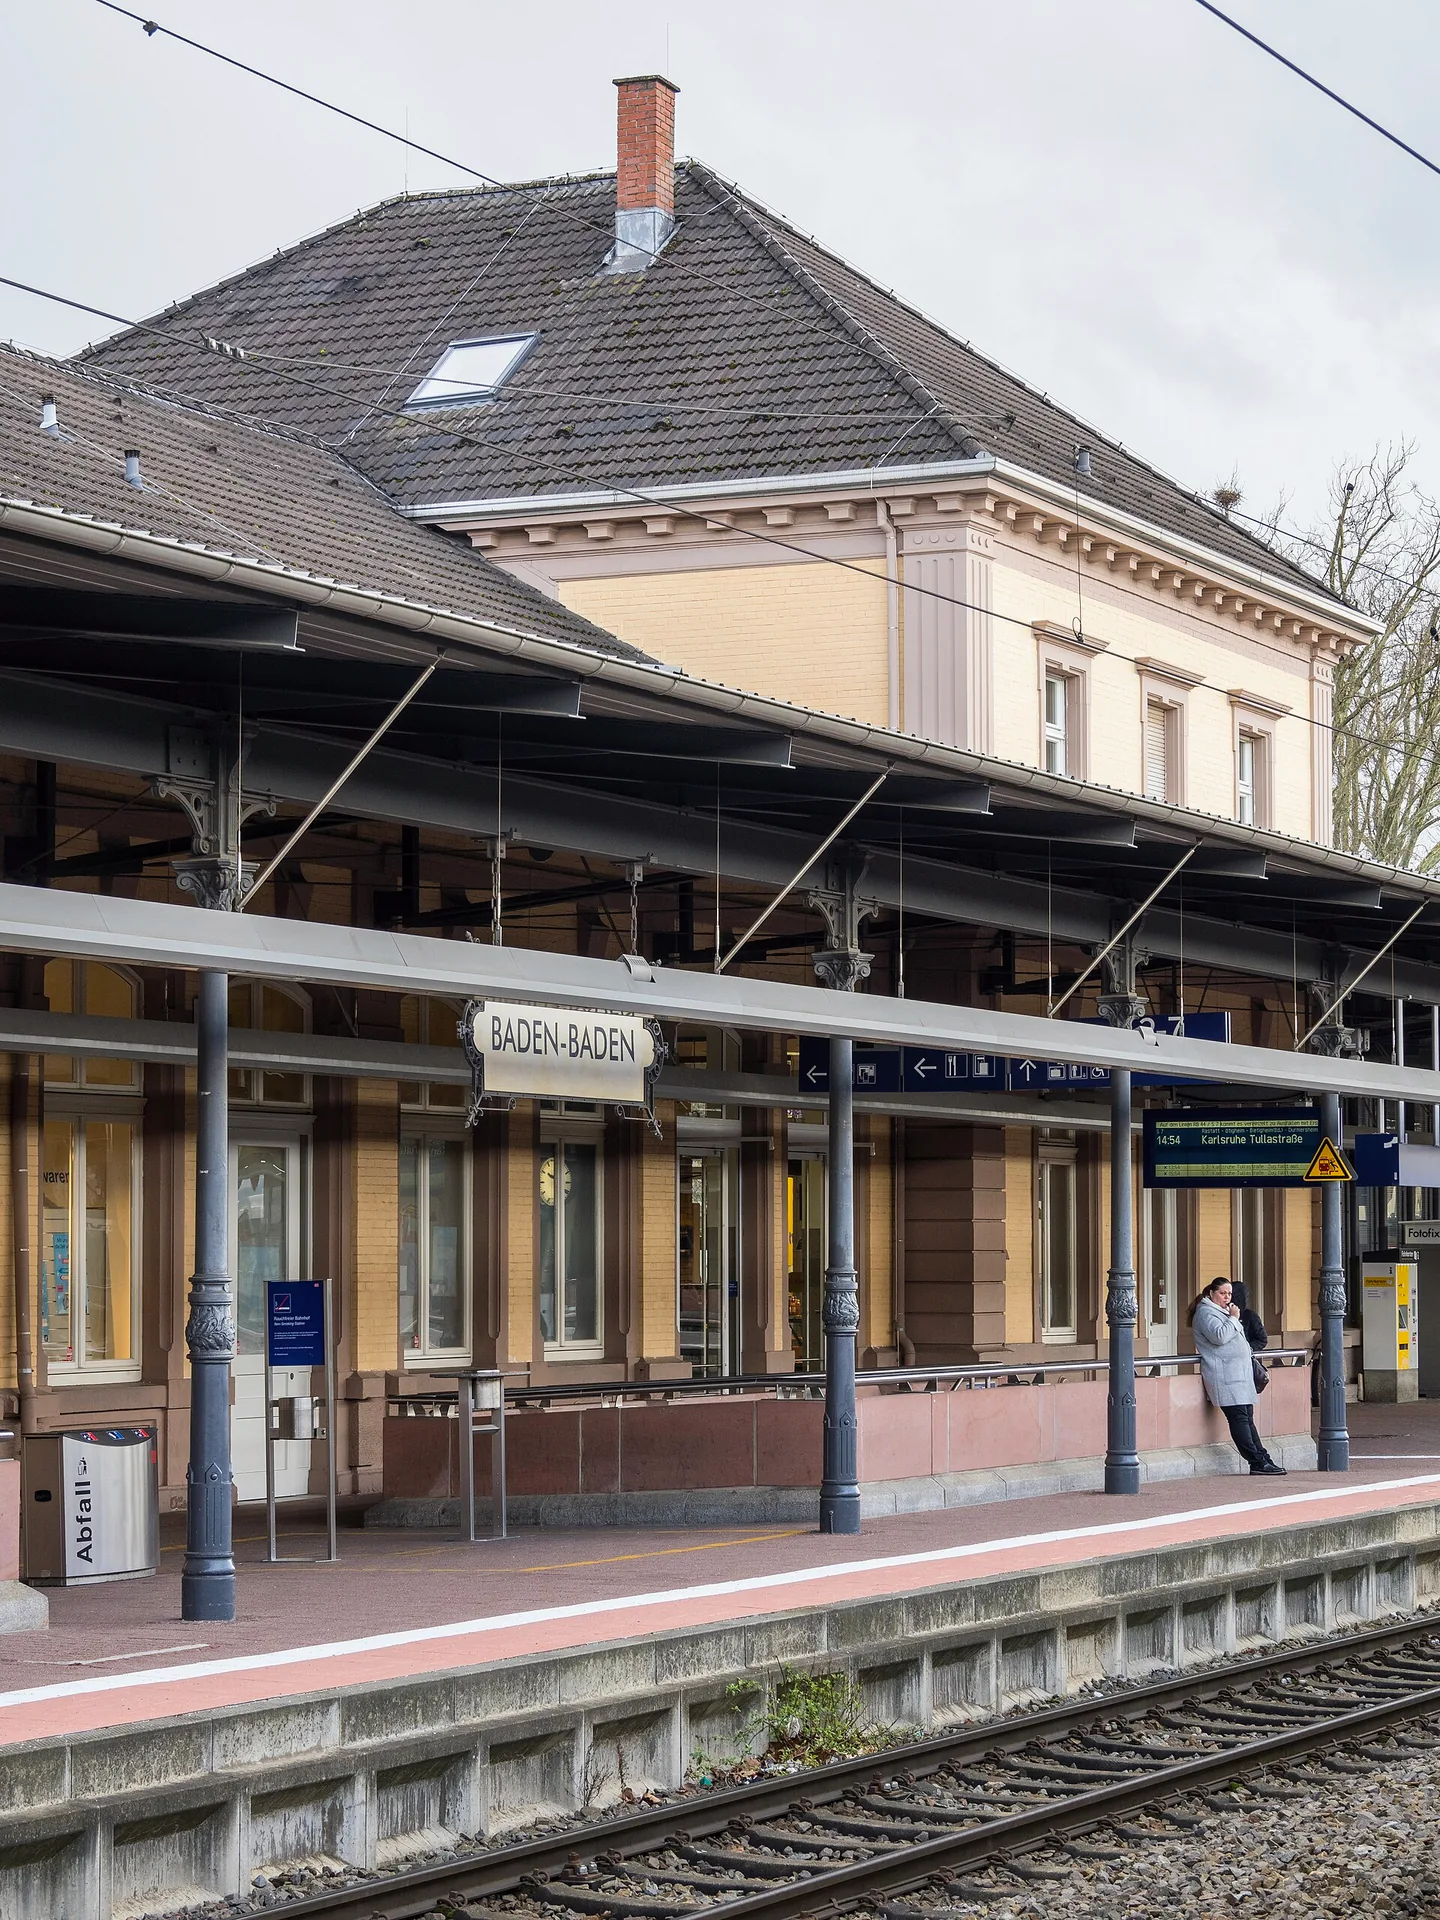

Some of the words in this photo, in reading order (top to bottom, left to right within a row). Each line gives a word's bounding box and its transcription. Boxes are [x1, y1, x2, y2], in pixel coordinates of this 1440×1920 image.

[491, 1015, 635, 1063] BADEN-BADEN
[1156, 1135, 1181, 1145] 14:54
[1201, 1135, 1247, 1145] Karlsruhe
[1249, 1134, 1303, 1144] Tullastraße
[1408, 1227, 1440, 1238] Fotofix
[74, 1480, 93, 1564] Abfall
